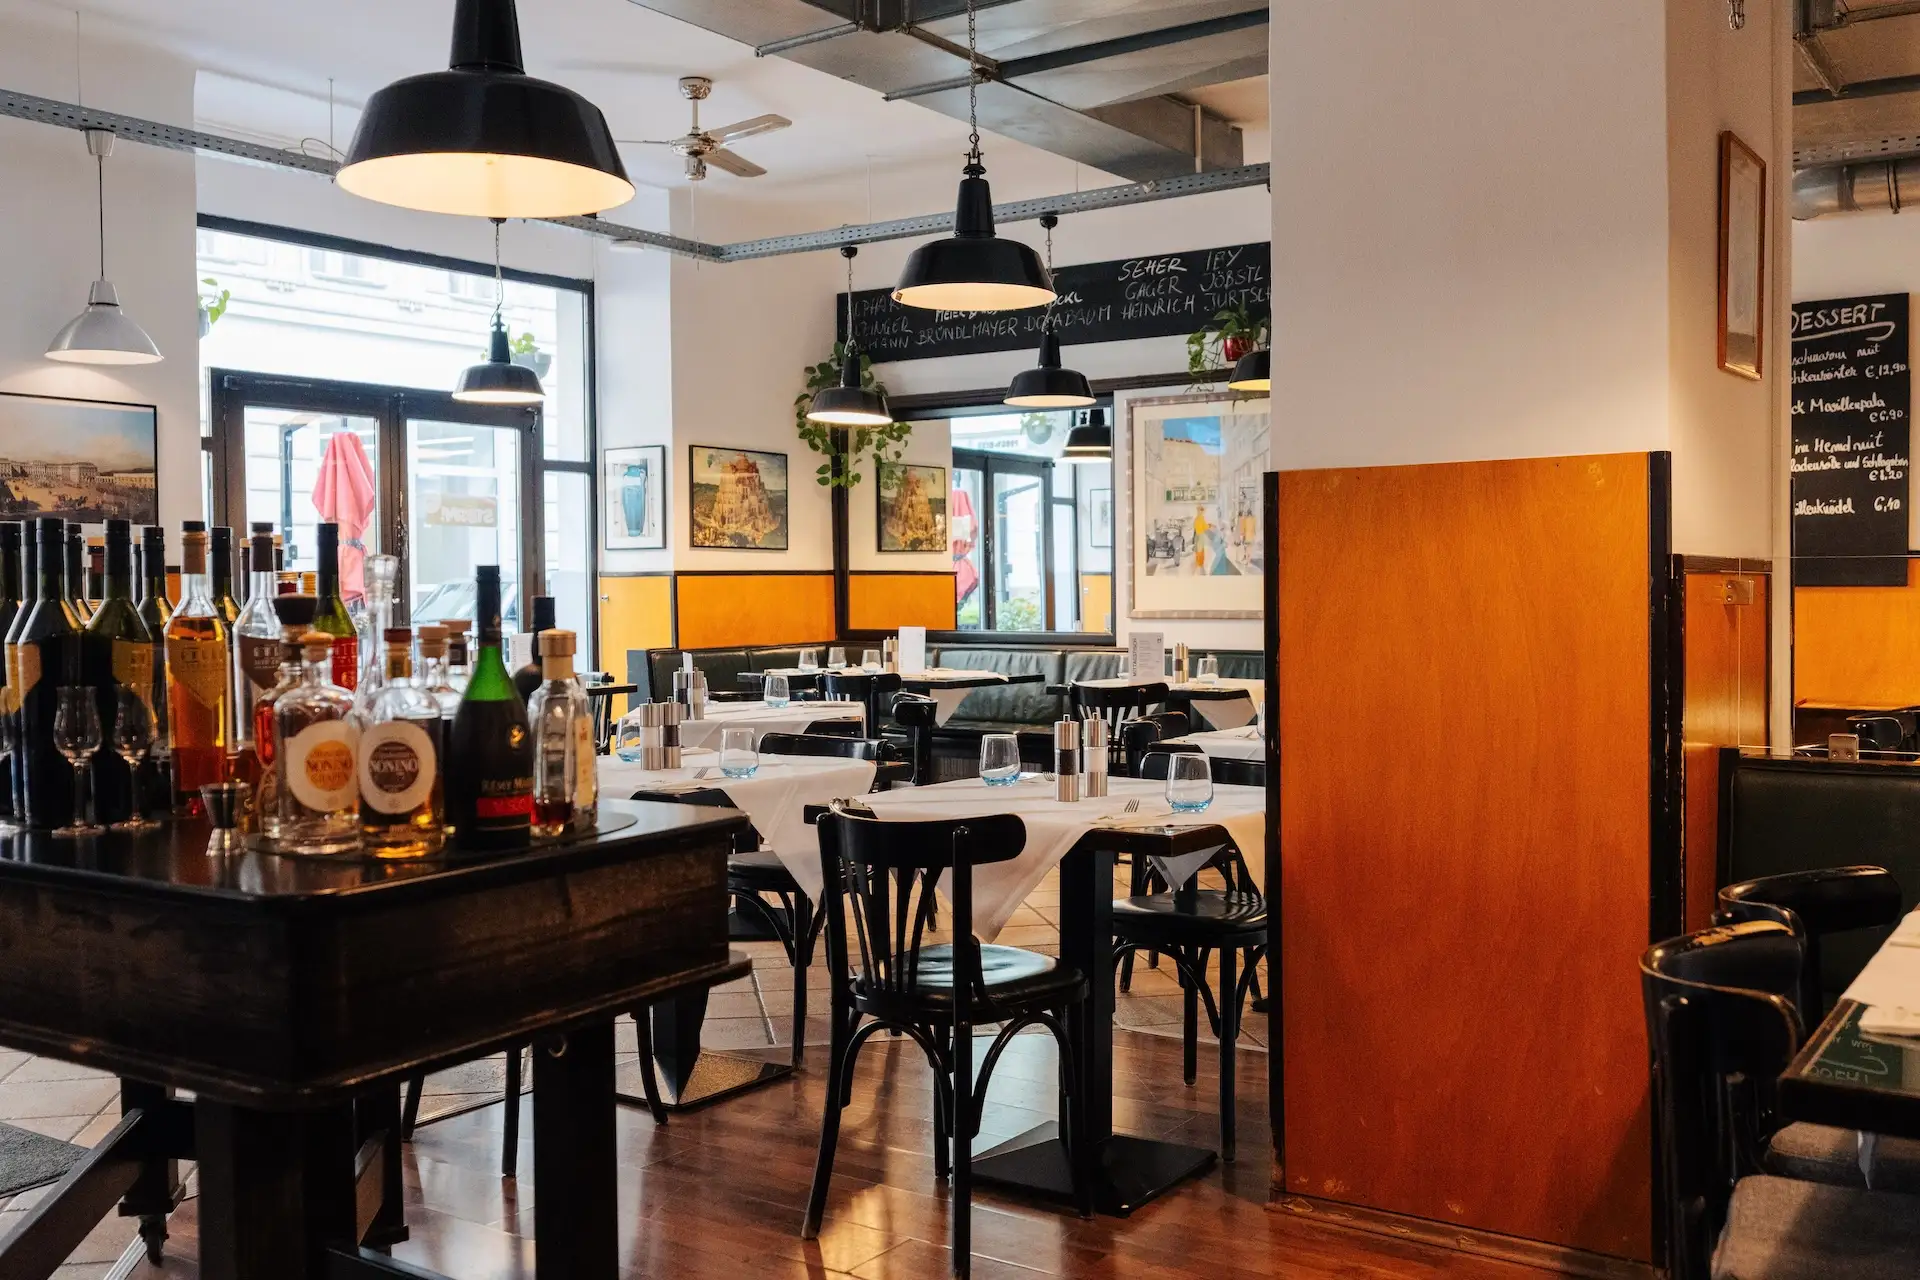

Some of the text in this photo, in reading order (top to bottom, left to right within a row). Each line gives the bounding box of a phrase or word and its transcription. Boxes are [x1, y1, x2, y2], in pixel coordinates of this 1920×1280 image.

[1125, 275, 1183, 300] GAGER
[1121, 294, 1195, 320] HEINRICH
[915, 317, 1018, 346] BRÜNDLMAYER
[1814, 435, 1851, 453] Hemd
